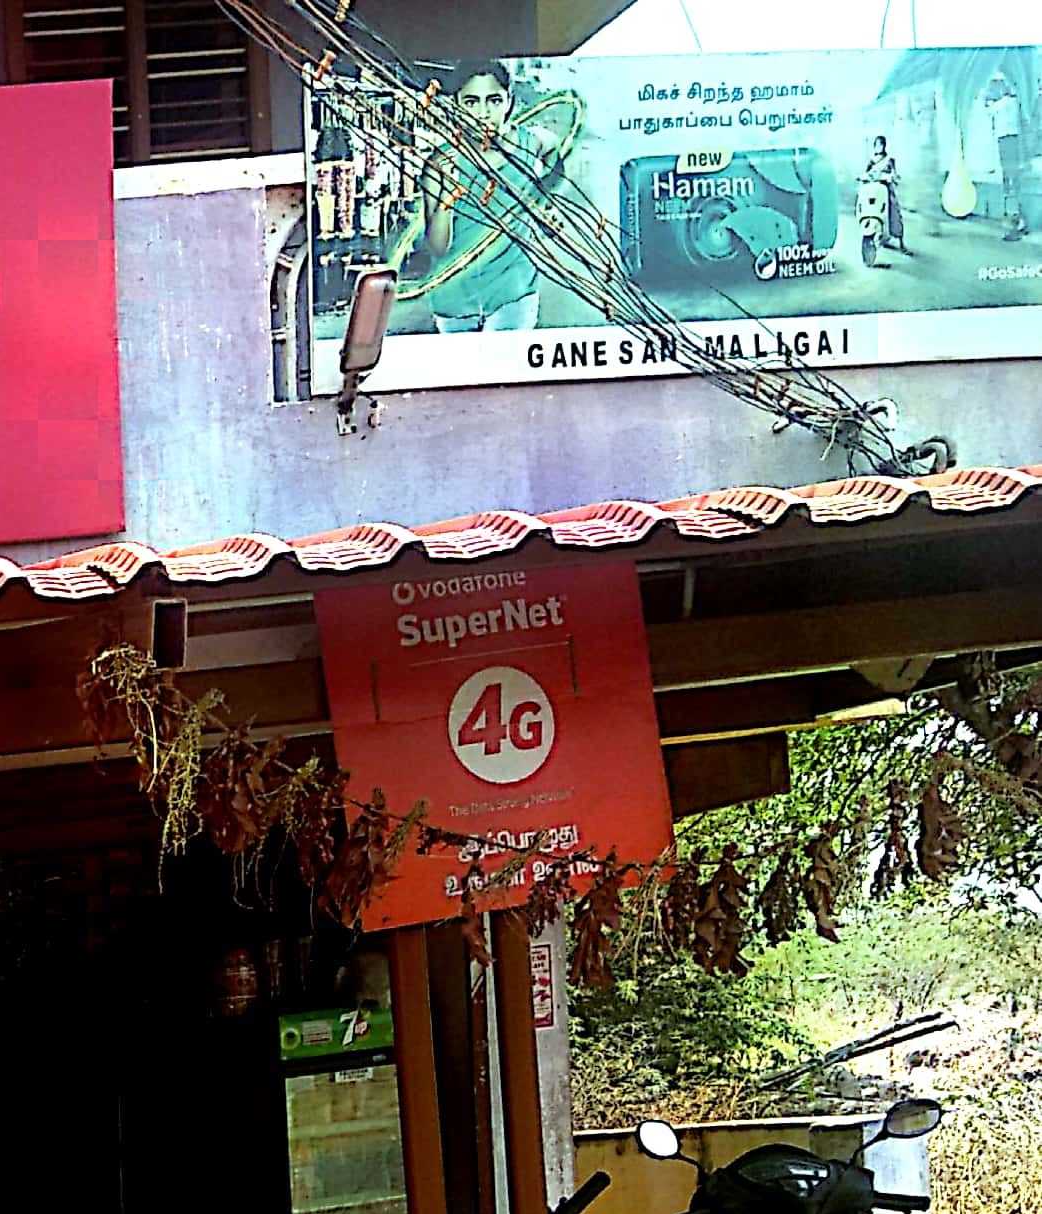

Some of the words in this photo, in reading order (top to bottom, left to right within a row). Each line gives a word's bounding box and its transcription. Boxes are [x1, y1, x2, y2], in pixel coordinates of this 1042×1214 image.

[638, 83, 680, 101] மிகச்
[687, 82, 744, 104] சிறந்த
[619, 111, 732, 134] பாதுகாப்பை
[687, 152, 722, 167] new
[652, 171, 755, 199] Hamam
[777, 244, 811, 261] 100%
[779, 262, 813, 277] NEEM
[417, 571, 527, 599] vodafone
[457, 683, 544, 756] 4G
